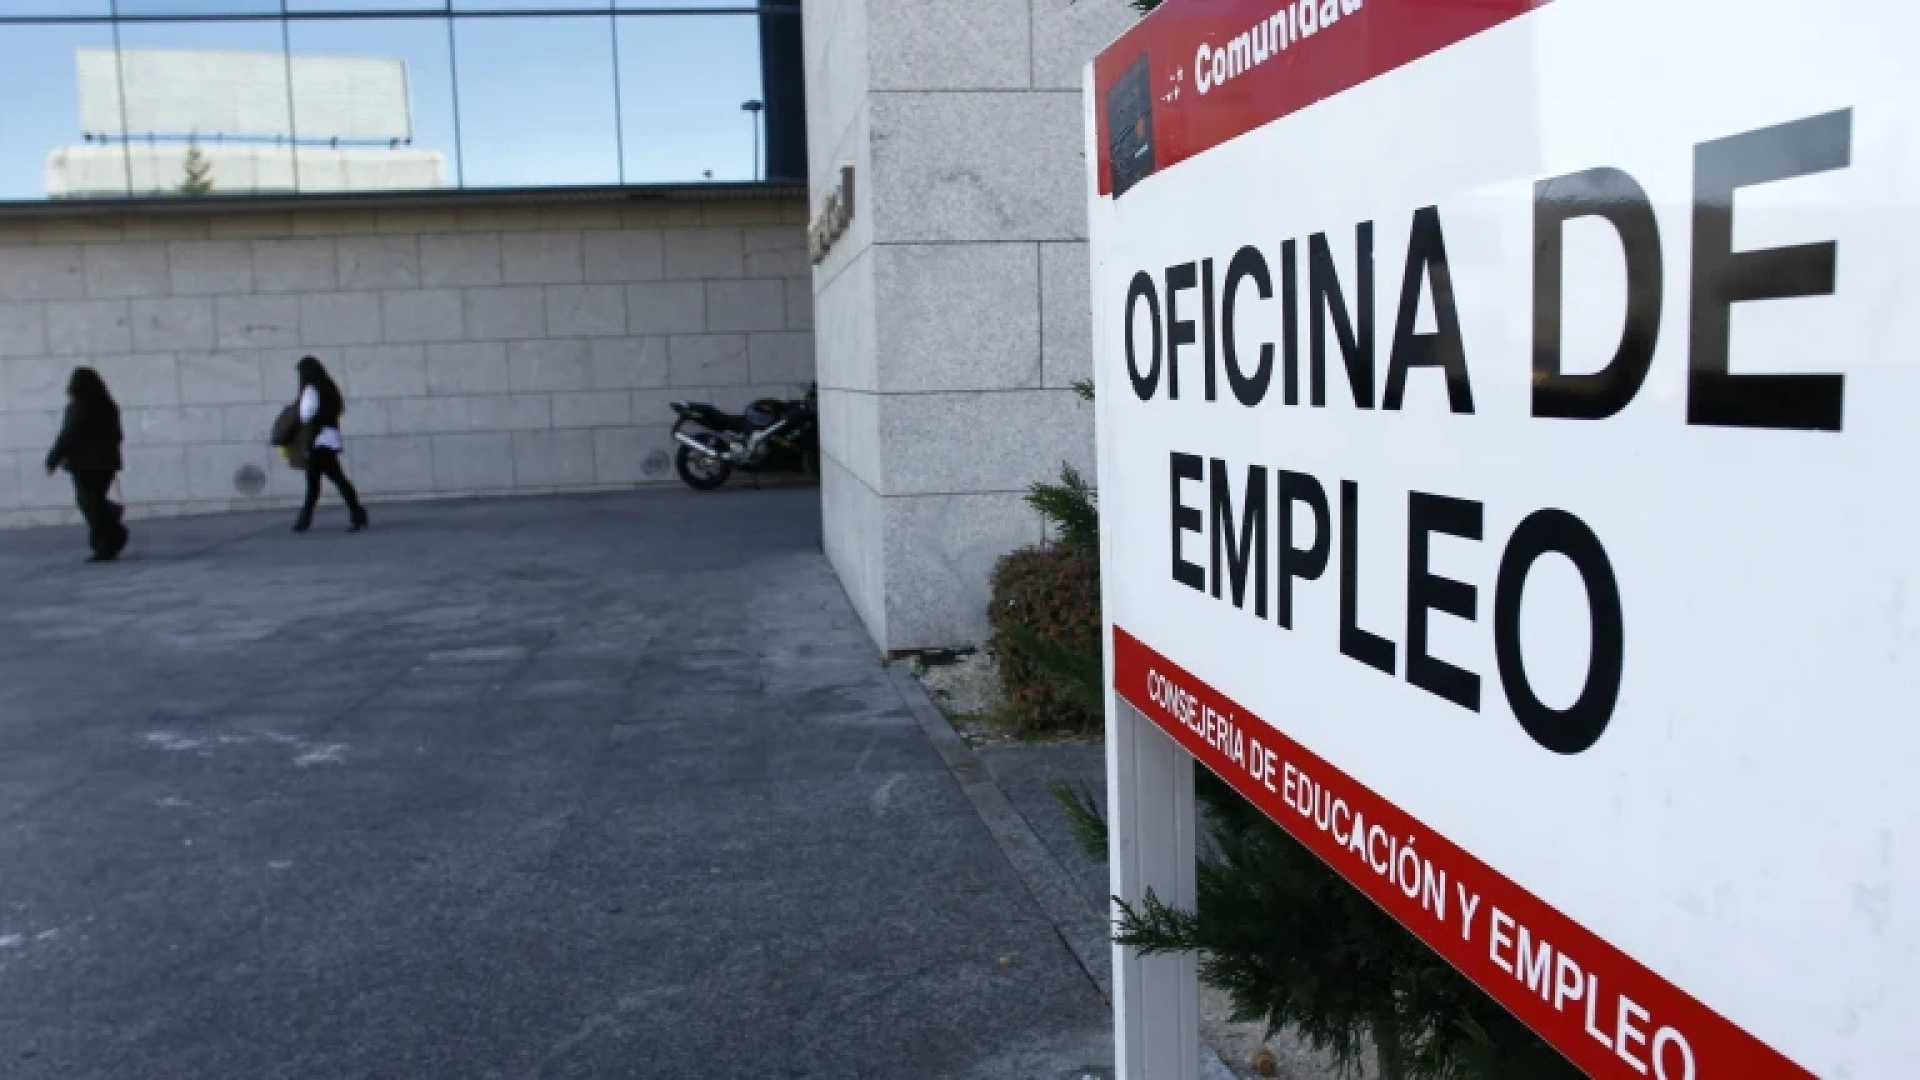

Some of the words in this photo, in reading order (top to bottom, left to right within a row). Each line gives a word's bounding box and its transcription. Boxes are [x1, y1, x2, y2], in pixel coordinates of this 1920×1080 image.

[1194, 0, 1363, 95] Comunida
[1125, 205, 1475, 415] OFICINA
[1531, 107, 1853, 432] DE
[1170, 451, 1624, 755] EMPLEO
[1148, 668, 1246, 769] CONSEJERÍA
[1250, 738, 1278, 793] DE
[1282, 761, 1447, 921] EDUCACIÓN
[1457, 882, 1481, 941] Y
[1490, 905, 1697, 1080] EMPLEO
